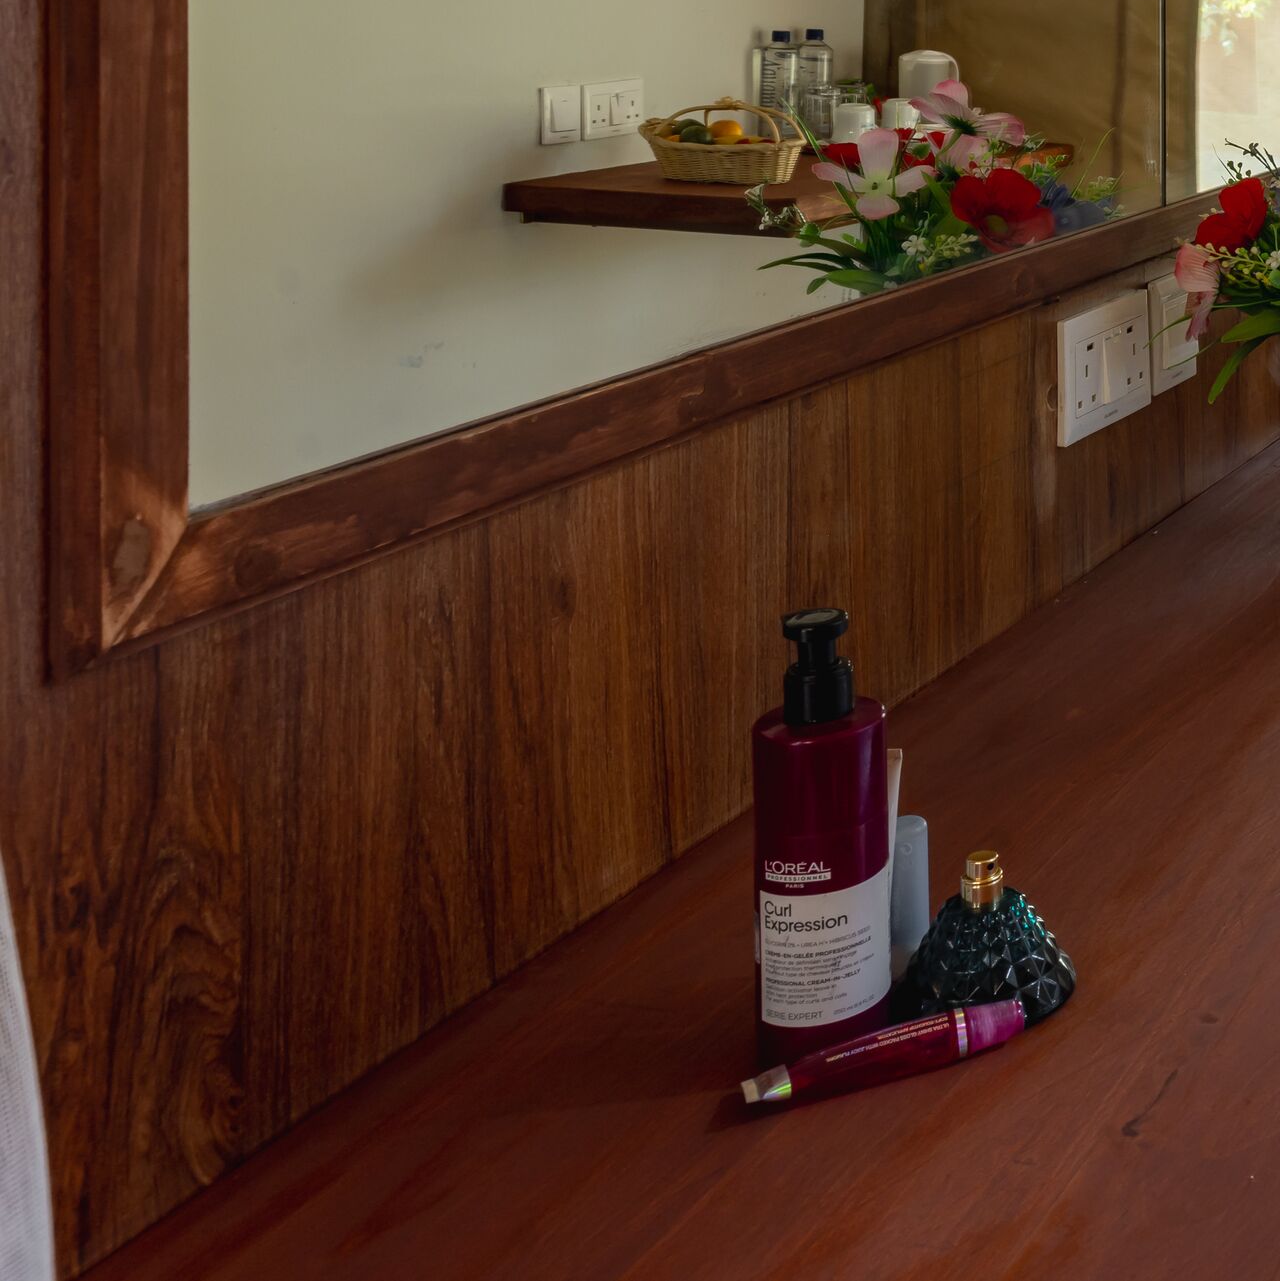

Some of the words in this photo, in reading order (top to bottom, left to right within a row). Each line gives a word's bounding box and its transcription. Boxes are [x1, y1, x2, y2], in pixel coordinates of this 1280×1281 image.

[764, 859, 832, 874] L'ORÉAL
[766, 873, 829, 882] PROFESSIONNEL
[764, 900, 792, 917] Curl
[764, 913, 849, 935] Expression
[787, 1010, 823, 1021] EXPERT
[932, 1022, 950, 1031] ULTRA
[878, 1036, 900, 1046] PACKED
[900, 1031, 917, 1041] GLOSS
